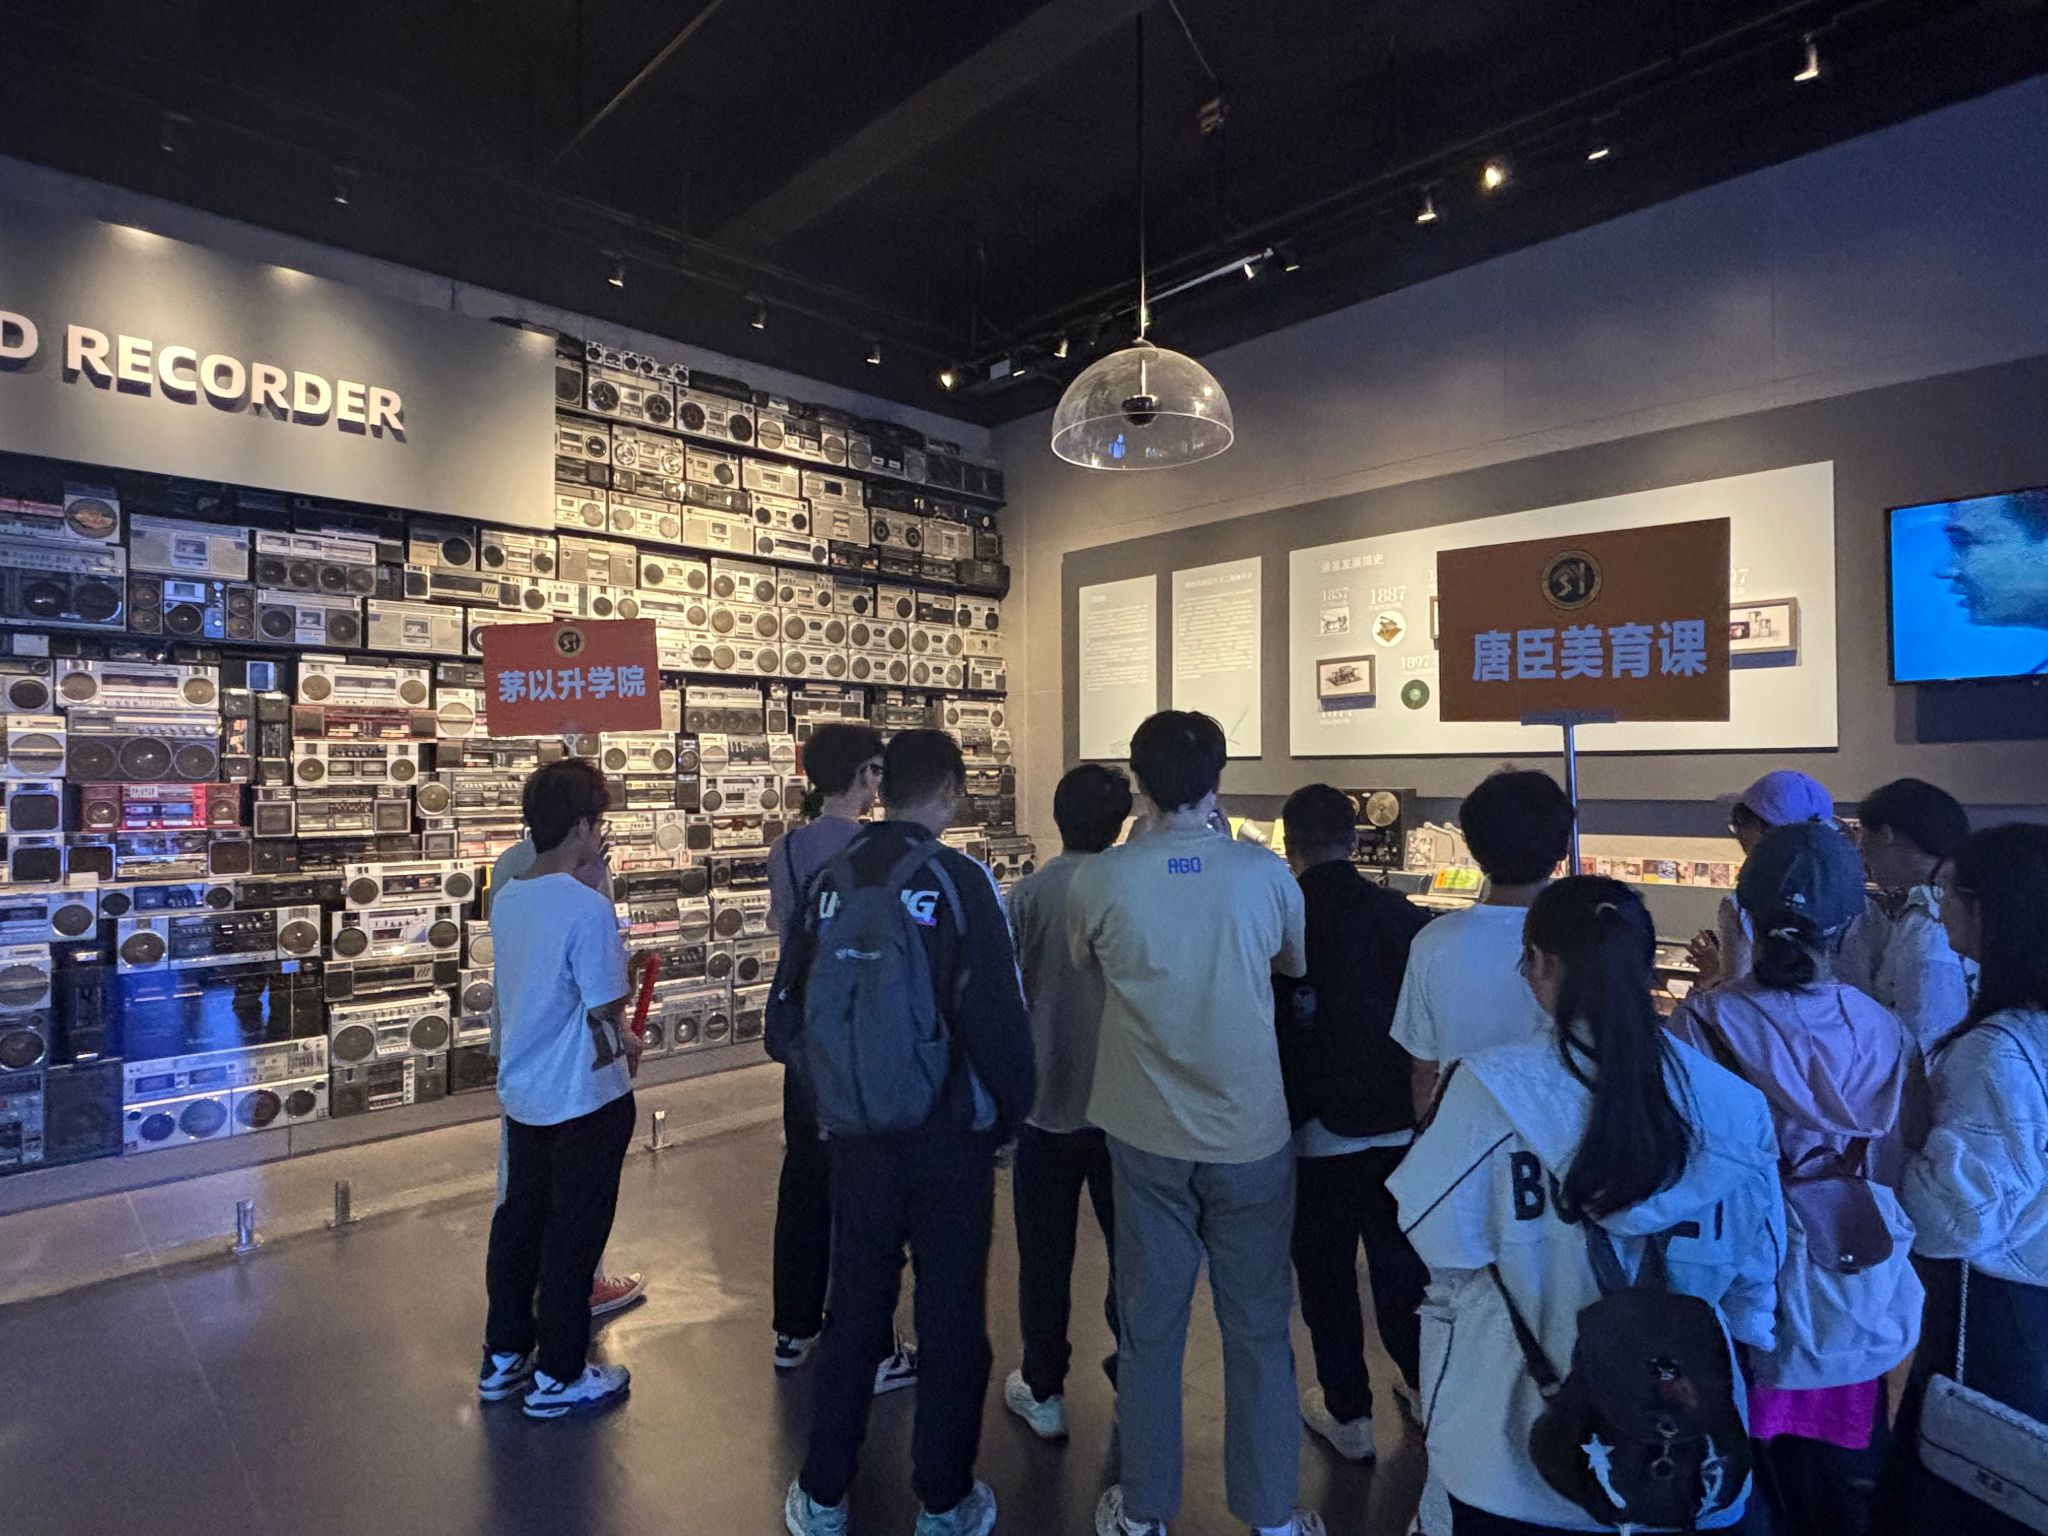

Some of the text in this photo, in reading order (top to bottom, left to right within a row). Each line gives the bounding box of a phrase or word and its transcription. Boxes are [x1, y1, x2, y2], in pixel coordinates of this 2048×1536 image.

[67, 324, 404, 431] RECORDER
[1369, 585, 1407, 605] 1887
[1401, 656, 1431, 670] 1897
[1472, 619, 1708, 682] 唐臣美育课
[498, 664, 646, 704] 茅以升学院
